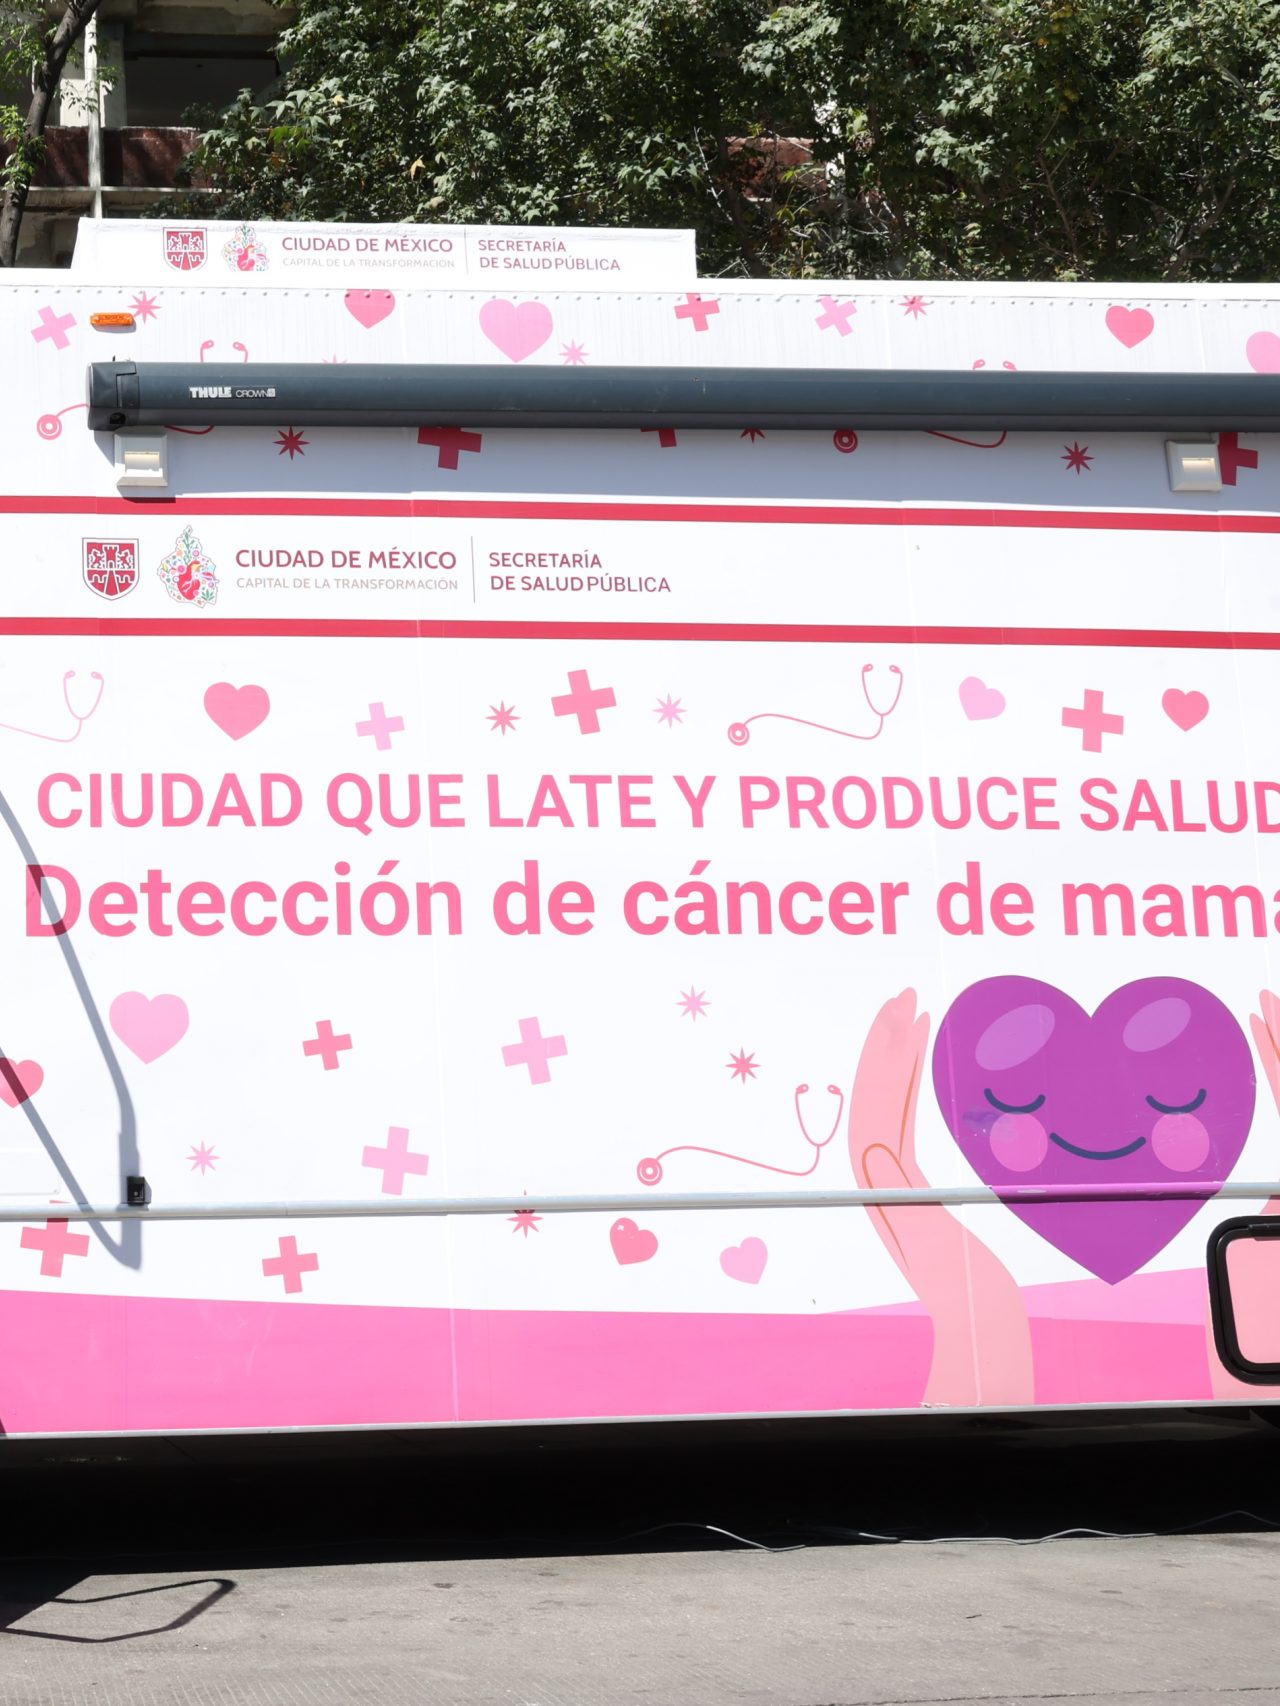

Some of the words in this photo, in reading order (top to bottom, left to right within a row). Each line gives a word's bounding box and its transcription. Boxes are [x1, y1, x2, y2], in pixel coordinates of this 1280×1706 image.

[282, 237, 350, 251] CIUDAD
[355, 238, 379, 252] DE
[385, 231, 453, 253] MÉXICO
[478, 237, 566, 252] SECRETARÍA
[282, 257, 324, 267] CAPITAL
[326, 258, 340, 267] DE
[342, 258, 355, 267] LA
[358, 254, 455, 268] TRANSFORMACIÓN
[479, 256, 499, 269] DE
[503, 257, 552, 270] SALUD
[554, 255, 621, 271] PÚBLICA
[189, 386, 232, 398] THULE
[235, 549, 324, 568] CIUDAD
[331, 550, 361, 568] DE
[368, 546, 456, 570] MÉXICO
[489, 549, 602, 568] SECRETARÍA
[236, 577, 290, 588] CAPITAL
[293, 578, 311, 589] DE
[314, 578, 331, 589] LA
[333, 577, 458, 590] TRANSFORMACIÓN
[490, 575, 516, 591] DE
[521, 576, 584, 591] SALUD
[587, 573, 671, 592] PÚBLICA
[37, 772, 303, 828] CIUDAD
[326, 772, 465, 836] QUE
[487, 774, 656, 828] LATE
[673, 775, 717, 828] Y
[739, 775, 1060, 831] PRODUCE
[1080, 777, 1280, 834] SALUD
[23, 857, 462, 940] Detección
[493, 859, 595, 936] de
[634, 860, 909, 936] cáncer
[937, 861, 1035, 936] de
[1062, 883, 1280, 938] mam
